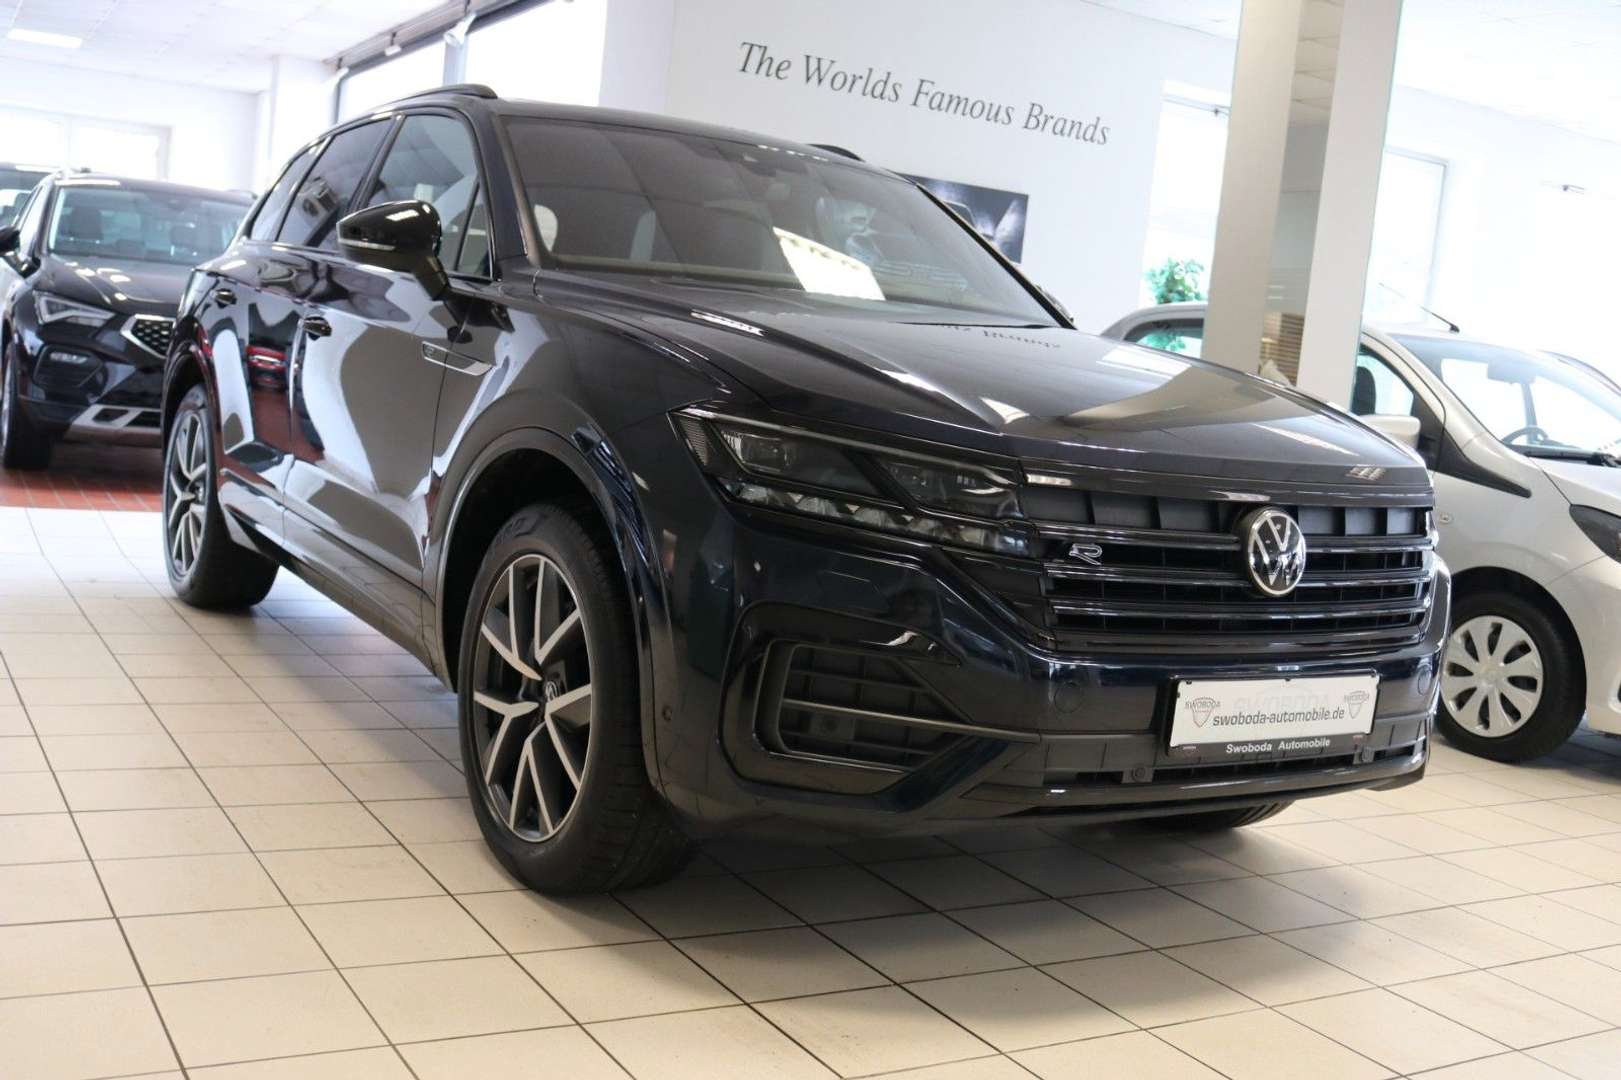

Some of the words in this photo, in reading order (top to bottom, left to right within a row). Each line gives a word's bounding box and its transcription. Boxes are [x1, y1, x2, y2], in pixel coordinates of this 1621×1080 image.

[737, 40, 792, 81] The
[801, 54, 903, 103] Worlds
[911, 79, 1015, 127] Famous
[1022, 102, 1111, 146] Brands
[1212, 706, 1345, 726] swoboda-automobile.de
[1225, 742, 1273, 754] Swoboda
[1278, 737, 1331, 751] Automobile
